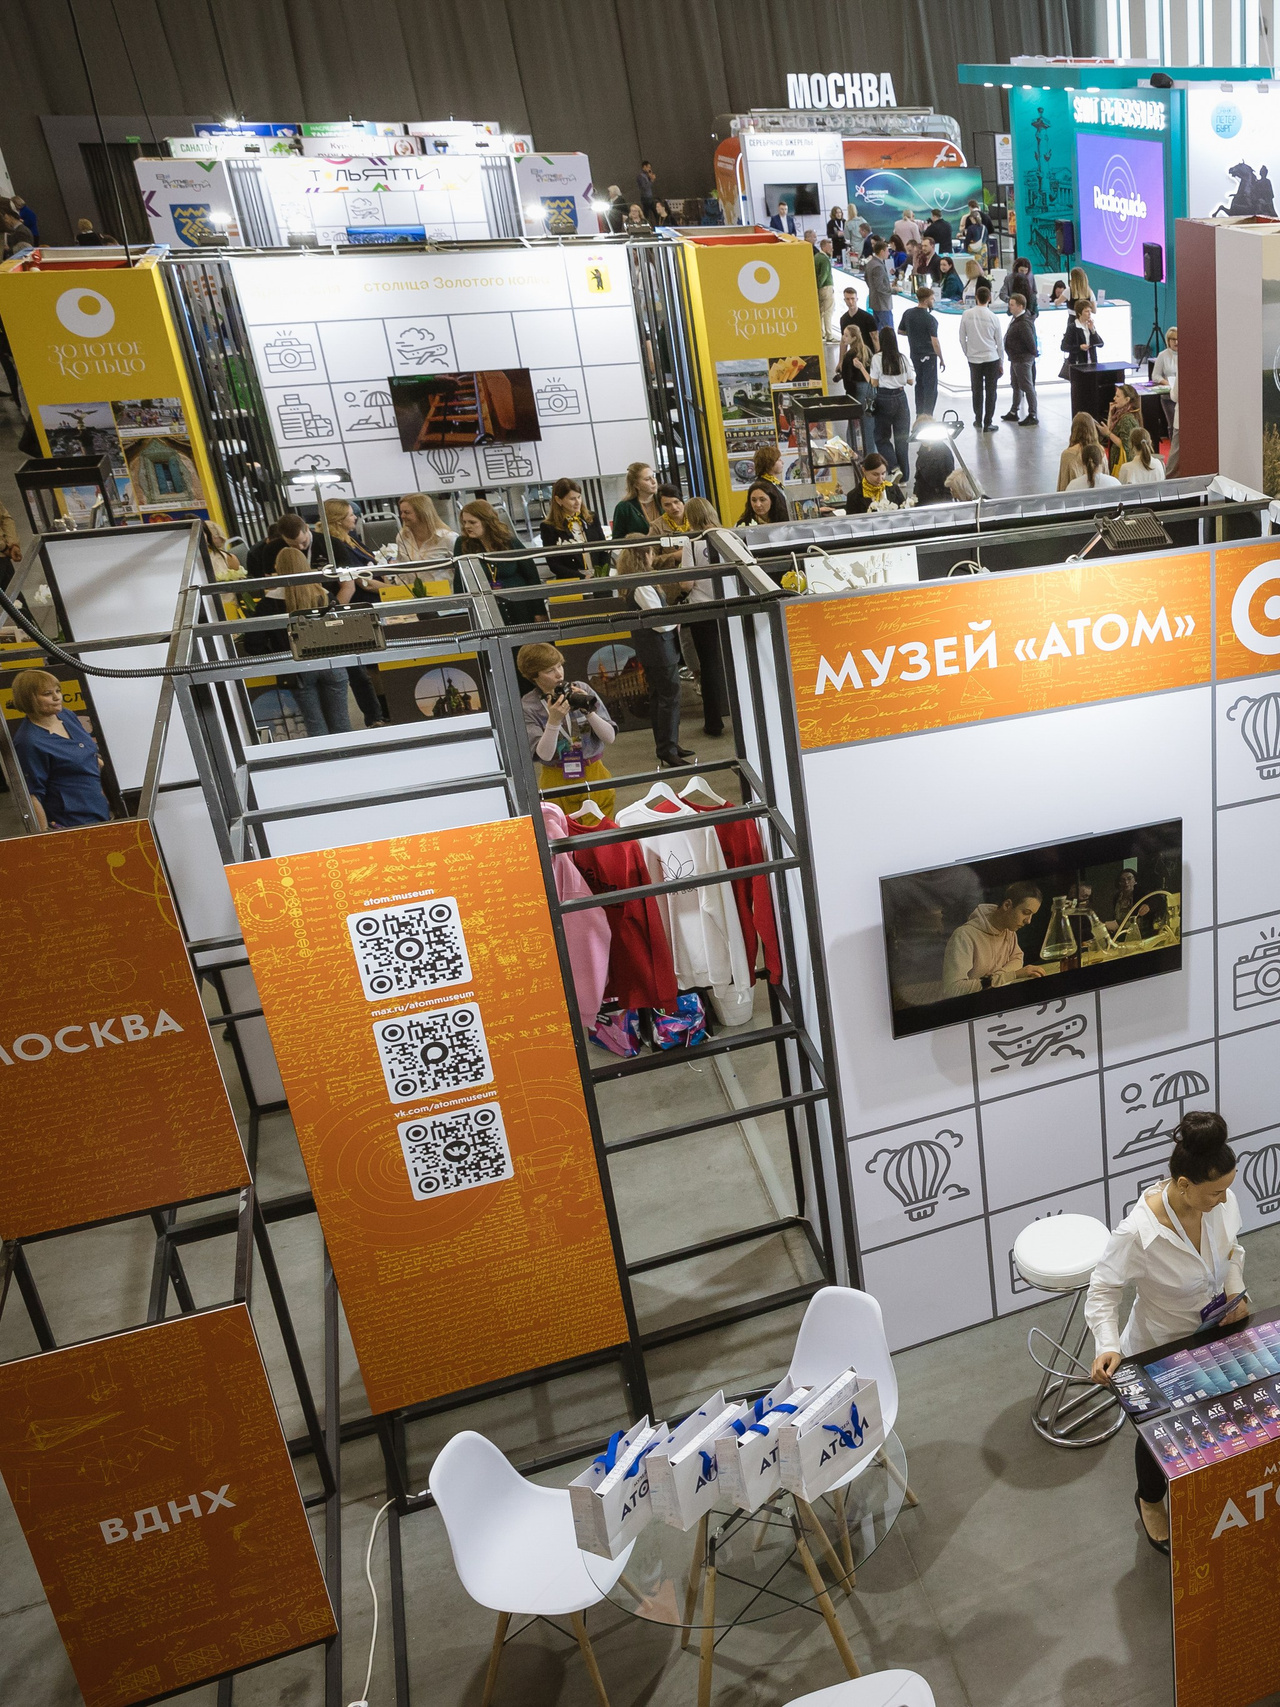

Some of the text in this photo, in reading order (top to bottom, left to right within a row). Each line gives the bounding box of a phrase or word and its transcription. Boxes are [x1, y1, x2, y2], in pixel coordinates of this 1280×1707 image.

[787, 72, 898, 109] МОСКВА
[1216, 115, 1236, 124] ПЕТЕР
[1216, 124, 1233, 133] БУРГ
[772, 149, 795, 157] РОССИИ
[1093, 185, 1147, 222] Radioguide
[363, 279, 430, 292] столица
[434, 275, 504, 289] Золотого
[728, 306, 798, 325] ЗОЛОТОЕ
[735, 320, 798, 340] КОЛЬЦО
[48, 341, 145, 363] ЗОЛОТОЕ
[59, 358, 146, 380] КОЛЬЦО
[815, 620, 998, 695] МУЗЕЙ
[1014, 605, 1196, 662] «АТОМ»
[363, 888, 435, 906] atom.museum
[371, 991, 475, 1017] max.ru/atommuseum
[393, 1089, 497, 1119] vk.com/atommuseum
[1253, 1391, 1268, 1401] АТО
[1208, 1406, 1224, 1418] АТО
[760, 1448, 778, 1475] АТ
[621, 1483, 649, 1521] АТО
[99, 1484, 237, 1545] ВДНХ
